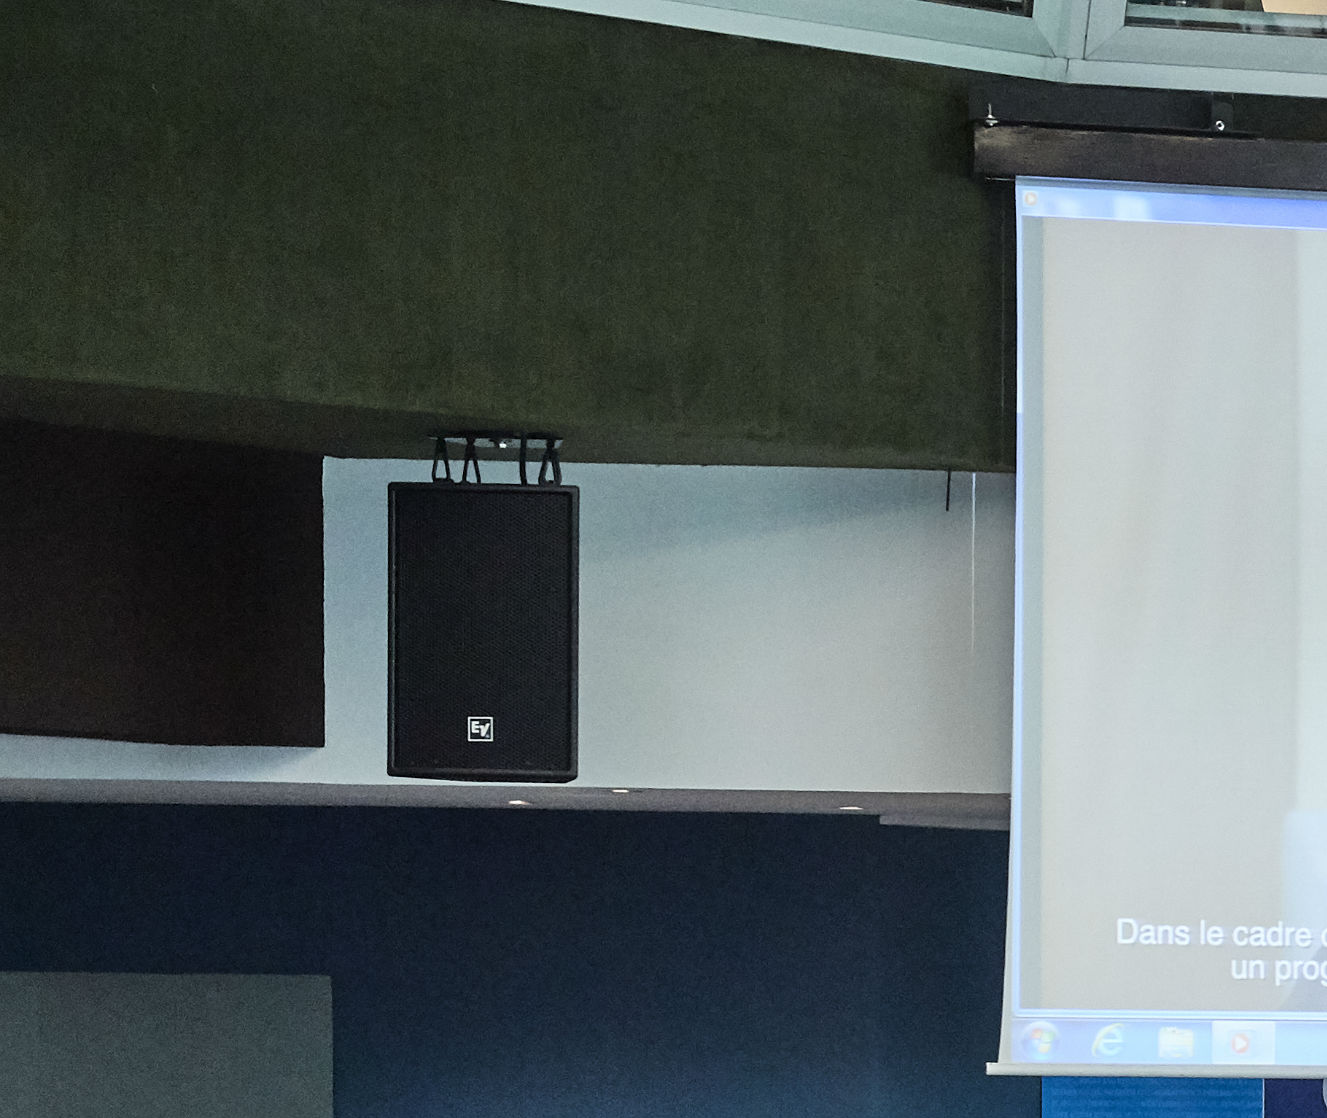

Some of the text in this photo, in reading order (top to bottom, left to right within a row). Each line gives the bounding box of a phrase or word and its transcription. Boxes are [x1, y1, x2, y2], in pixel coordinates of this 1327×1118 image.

[1116, 919, 1190, 946] Dans
[1200, 920, 1224, 947] le
[1233, 921, 1313, 948] cadre
[1230, 958, 1266, 981] un
